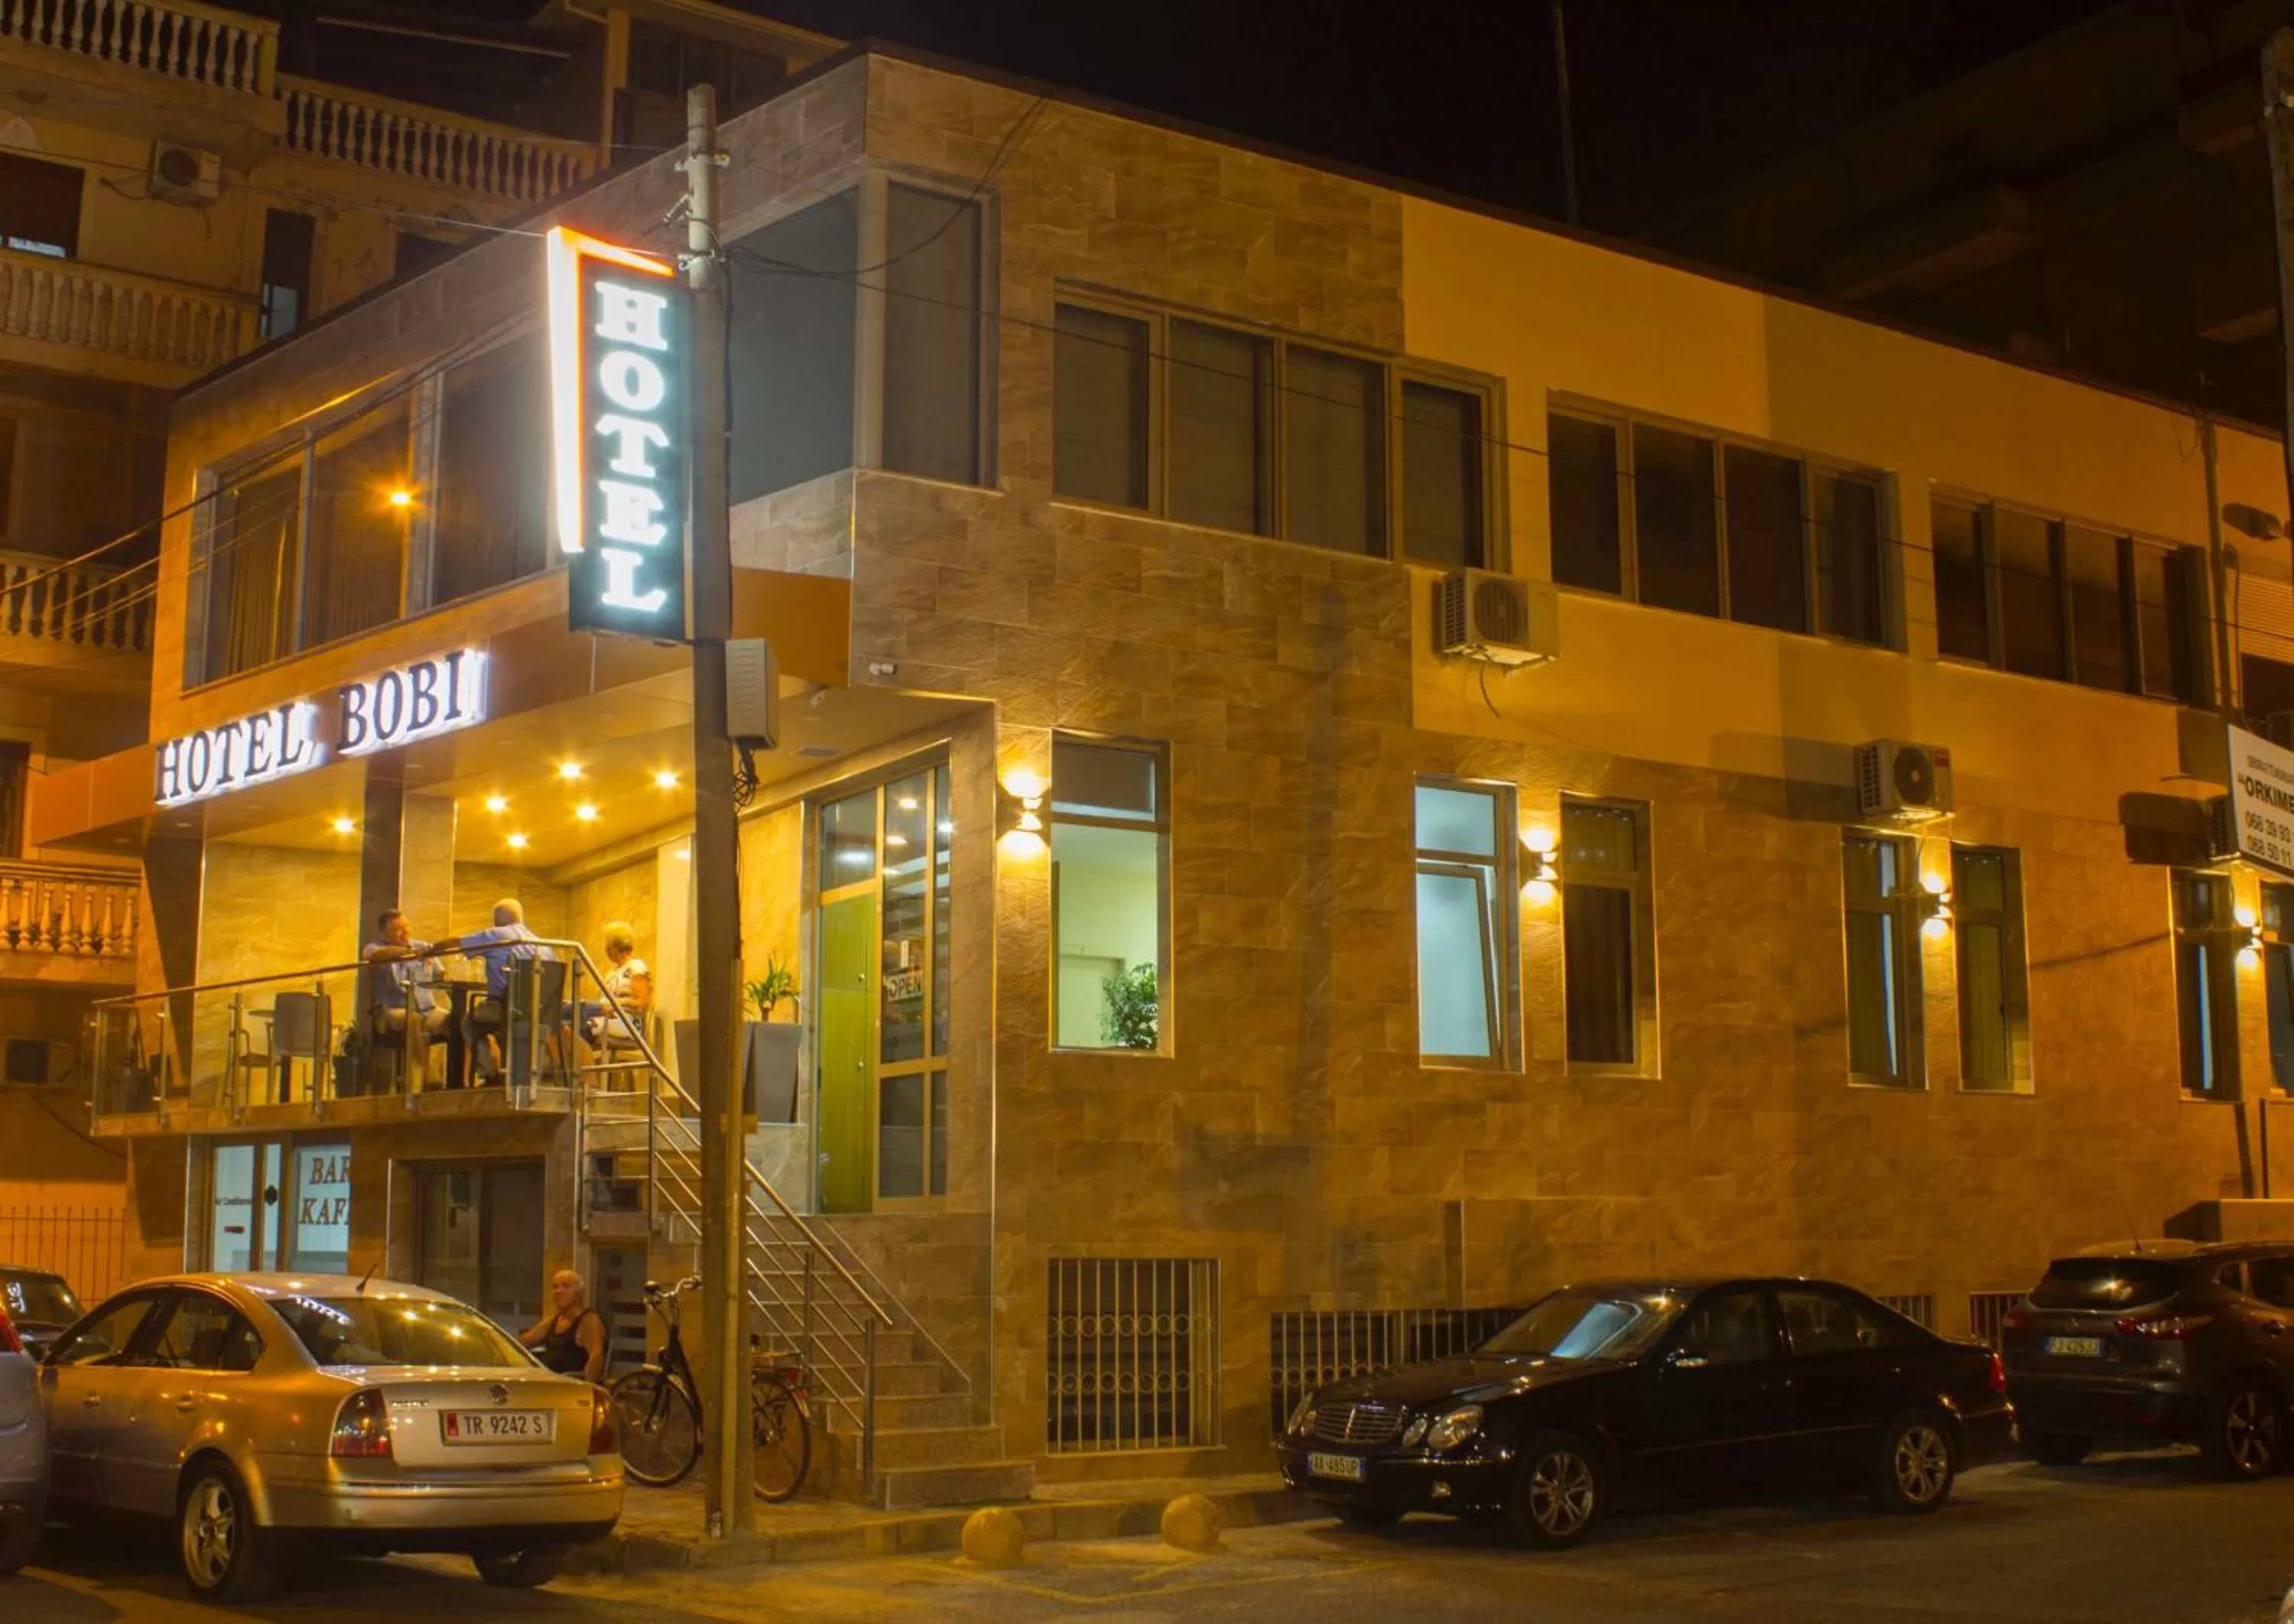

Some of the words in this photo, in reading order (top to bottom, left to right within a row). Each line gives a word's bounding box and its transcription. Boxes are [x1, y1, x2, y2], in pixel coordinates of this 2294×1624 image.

[596, 280, 670, 612] HOTEL
[154, 702, 308, 804] HOTEL
[337, 650, 474, 754] BOBI
[299, 1198, 349, 1225] KAF
[463, 1416, 483, 1434] TR
[490, 1416, 528, 1434] 9242
[534, 1416, 542, 1434] S
